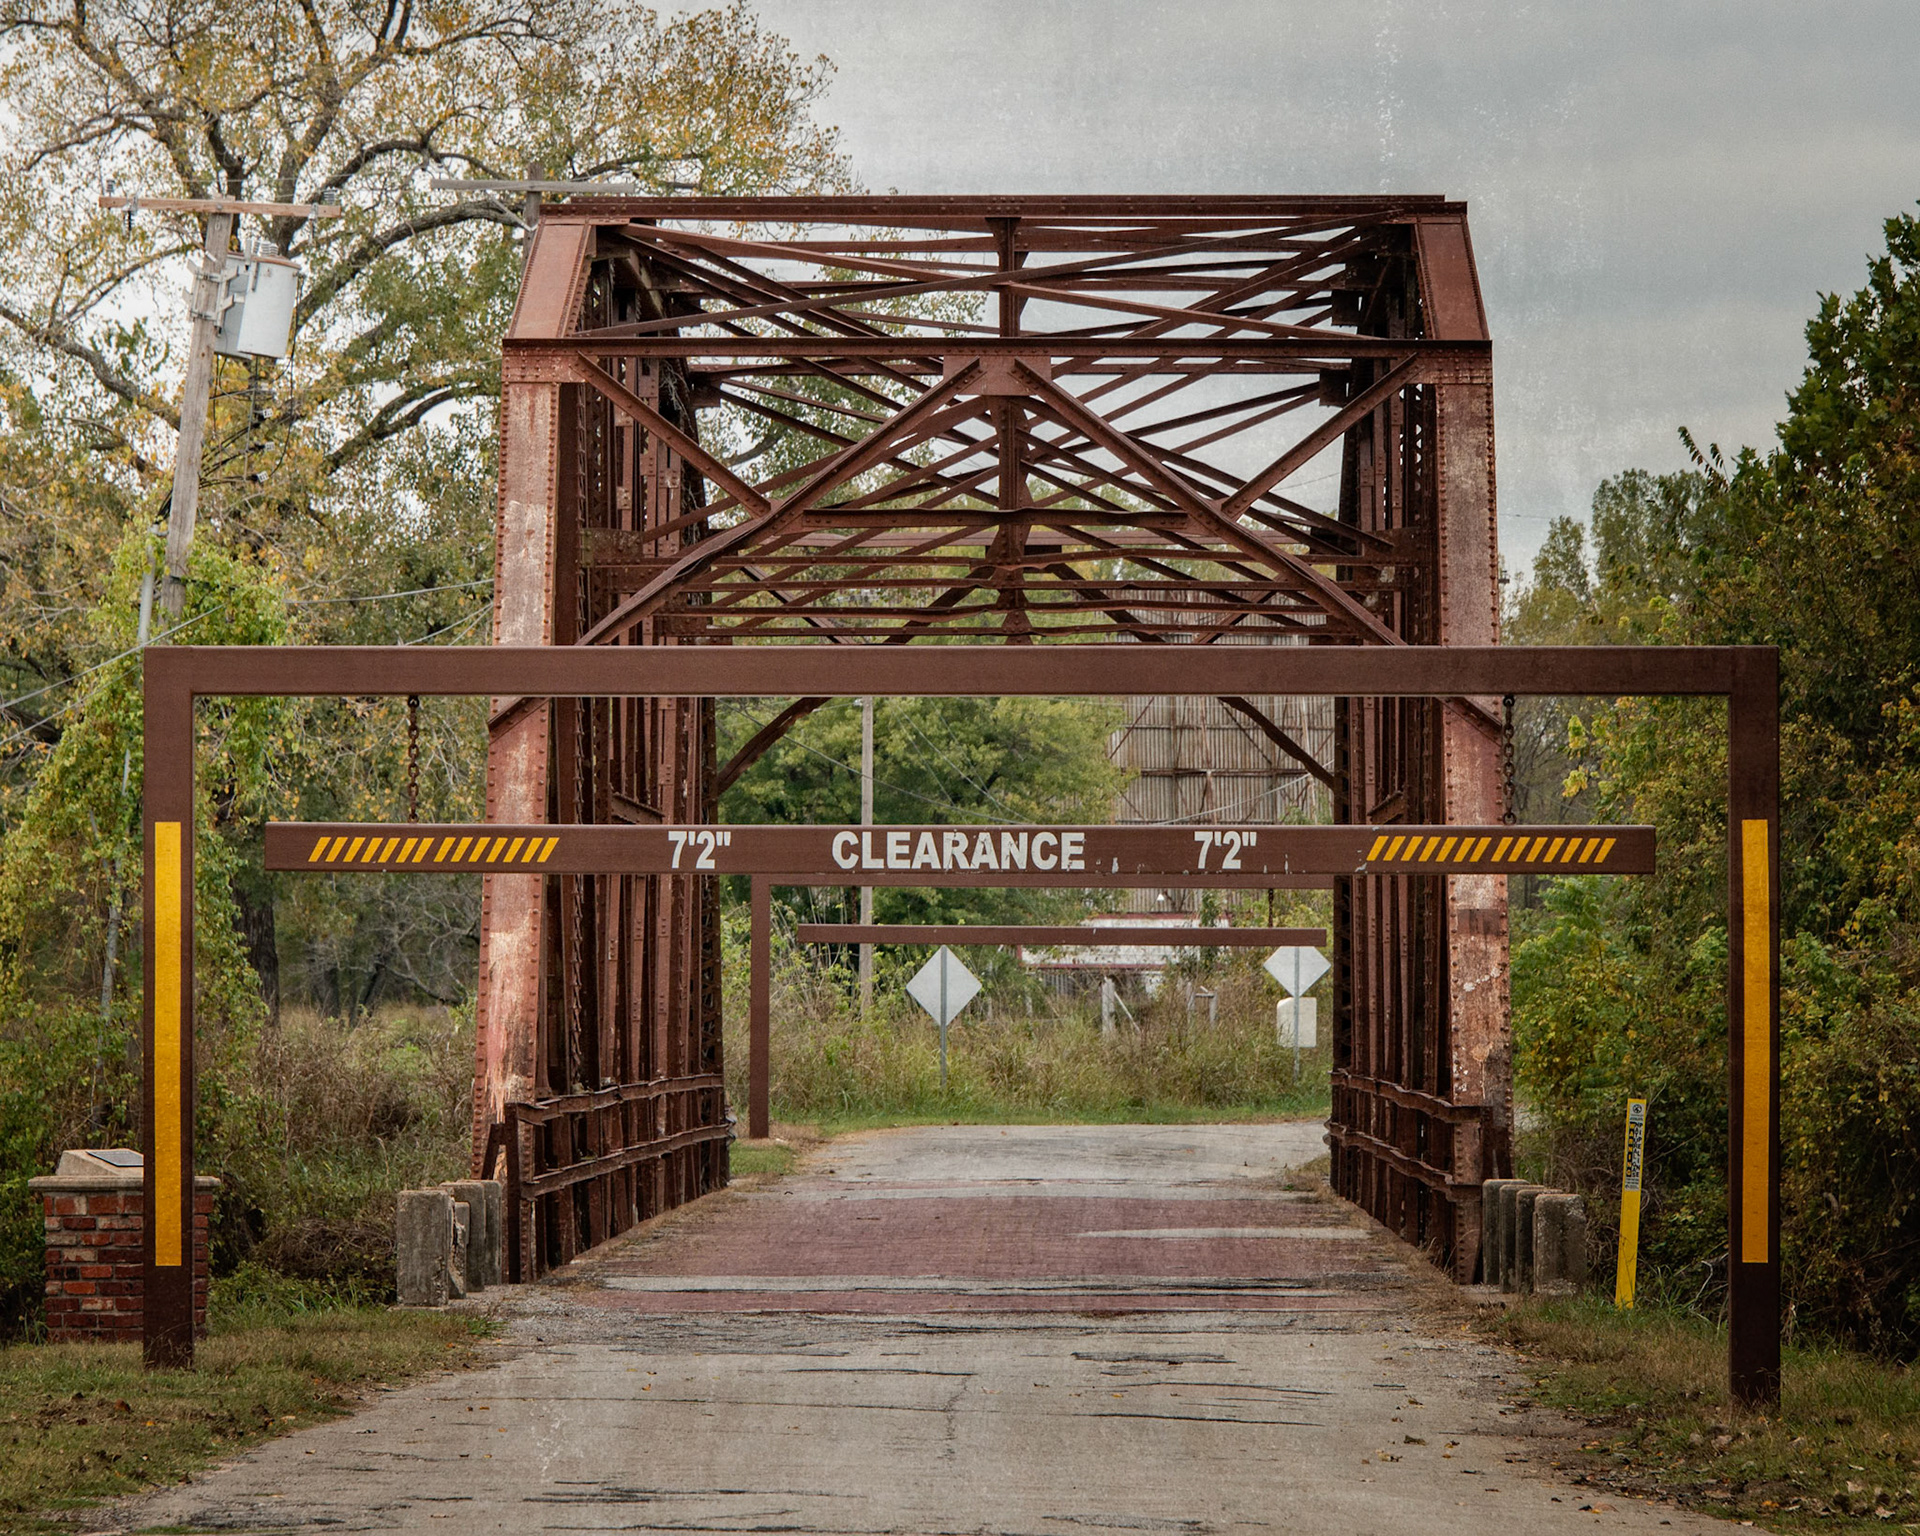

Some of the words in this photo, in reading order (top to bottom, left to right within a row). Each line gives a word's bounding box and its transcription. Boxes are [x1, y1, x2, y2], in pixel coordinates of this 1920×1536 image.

[668, 831, 731, 869] 7'2"
[832, 831, 1085, 870] CLEARANCE
[1195, 831, 1258, 869] 7'2"
